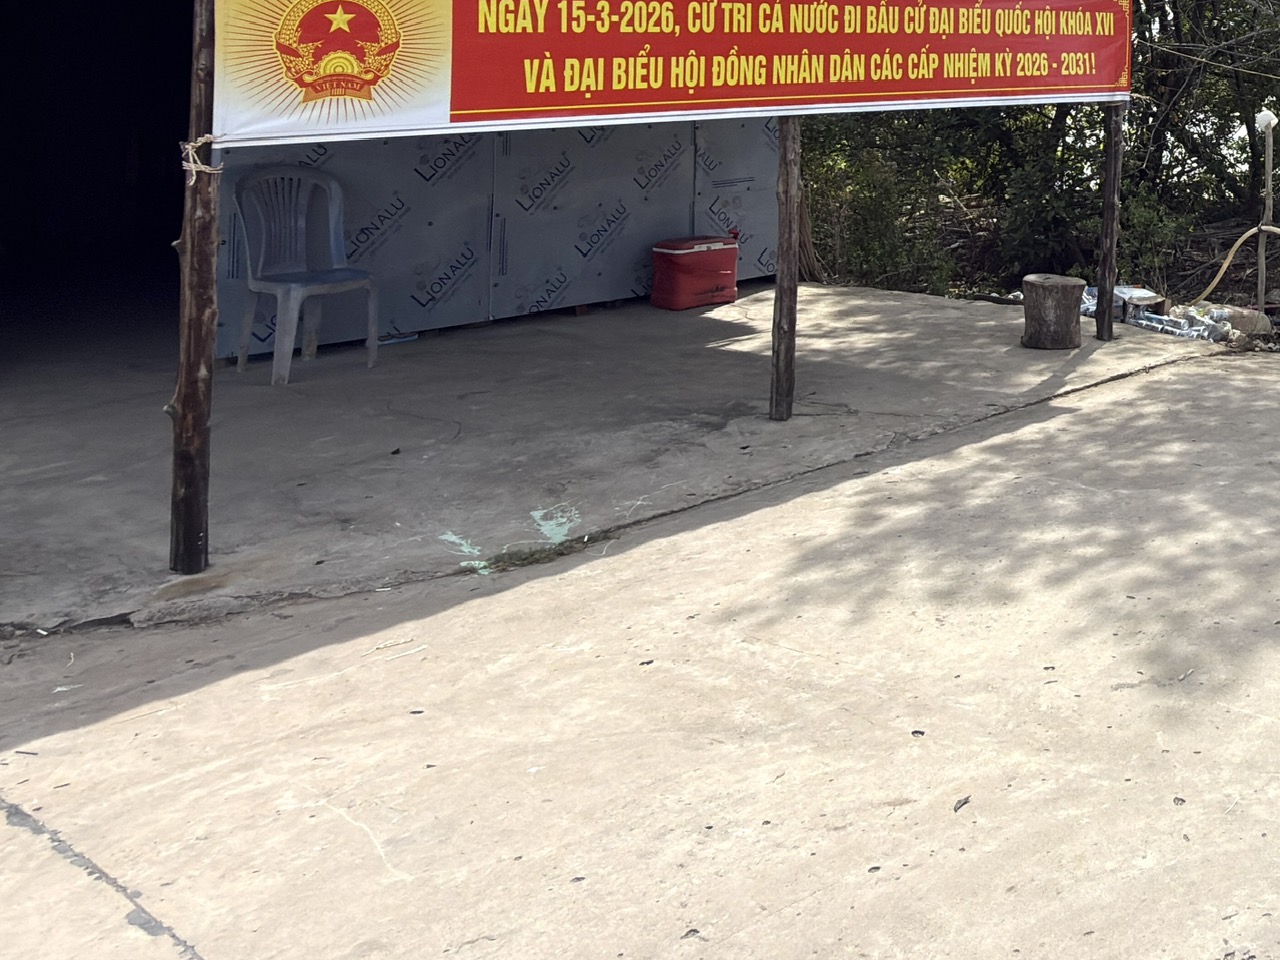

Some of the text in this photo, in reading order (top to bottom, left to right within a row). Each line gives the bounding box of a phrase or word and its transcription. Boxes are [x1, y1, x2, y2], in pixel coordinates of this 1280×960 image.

[557, 0, 681, 37] 15-3-2026,
[721, 2, 753, 33] TRI
[844, 5, 862, 34] ĐI
[929, 7, 955, 40] ĐẠI
[995, 1, 1031, 37] QUỐC
[1035, 6, 1057, 40] HỘI
[1060, 7, 1093, 36] KHÓA
[1095, 12, 1115, 36] XVI
[523, 51, 557, 94] VÀ
[563, 57, 605, 99] ĐẠI
[612, 43, 664, 90] BIỂU
[670, 49, 706, 95] HỘI
[712, 45, 767, 87] ĐỒNG
[772, 48, 825, 85] NHÂN
[829, 48, 866, 83] DÂN
[870, 48, 903, 81] CÁC
[908, 44, 940, 80] CẤP
[943, 48, 991, 85] NHIỆM
[995, 48, 1013, 78] KỲ
[1016, 52, 1049, 77] 2026
[1061, 52, 1096, 76] 2031!
